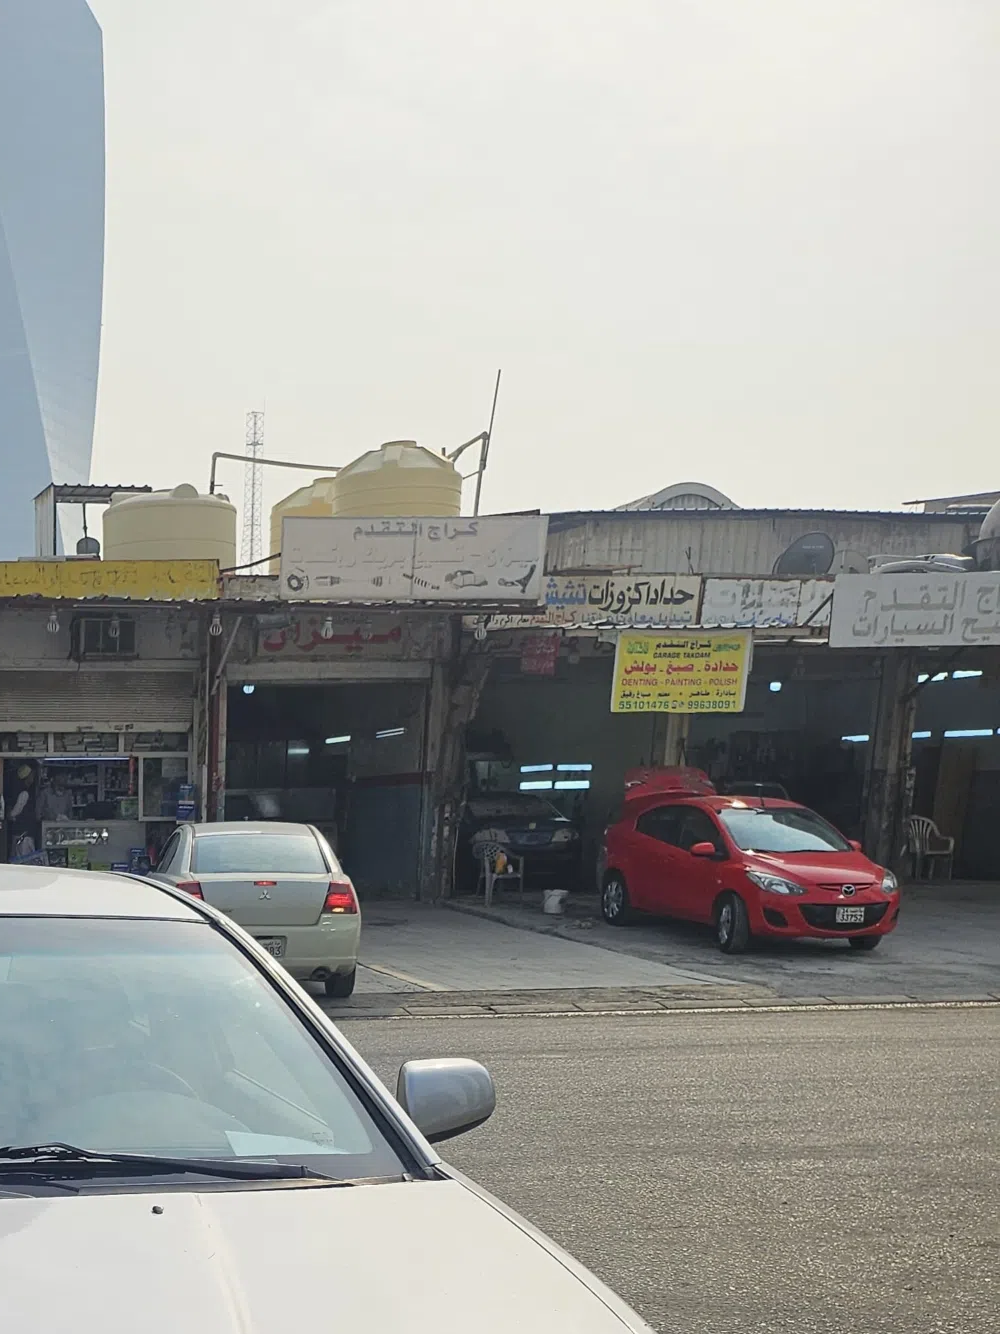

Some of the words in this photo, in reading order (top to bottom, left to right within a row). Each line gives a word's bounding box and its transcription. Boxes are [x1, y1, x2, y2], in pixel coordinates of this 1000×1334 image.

[353, 521, 422, 541] التقدم
[428, 522, 479, 540] كراج
[864, 580, 966, 613] التقدم
[852, 613, 954, 644] السيارات
[690, 640, 711, 650] كراج
[624, 660, 656, 675] بولش
[666, 660, 694, 675] صبغ
[704, 660, 738, 672] حدادة
[621, 678, 658, 687] DENTING
[665, 678, 701, 687] PAINTING
[709, 678, 738, 687] POLISH
